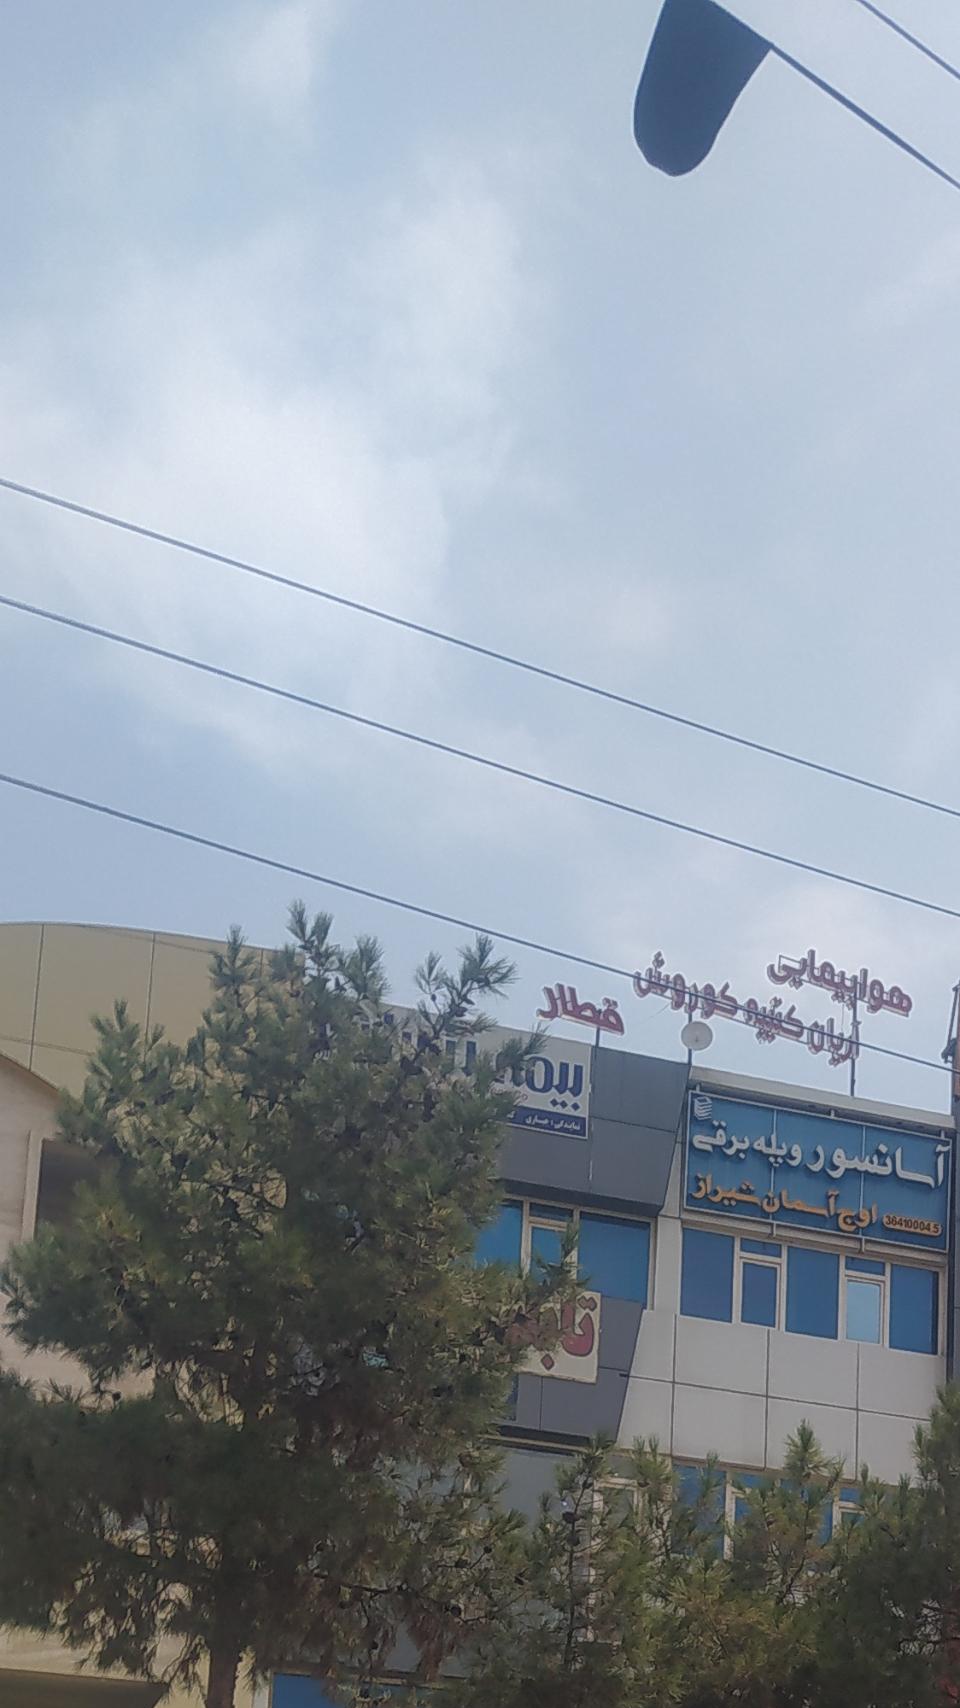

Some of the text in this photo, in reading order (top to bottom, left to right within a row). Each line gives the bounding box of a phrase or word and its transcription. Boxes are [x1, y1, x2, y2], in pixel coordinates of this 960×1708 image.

[536, 983, 625, 1036] قطار
[634, 951, 739, 1018] کوروش
[767, 949, 912, 1018] هواپیمایی
[692, 1120, 750, 1160] برقی
[806, 1143, 951, 1189] آسانسور
[691, 1172, 878, 1232] اوج آسمان شیراز
